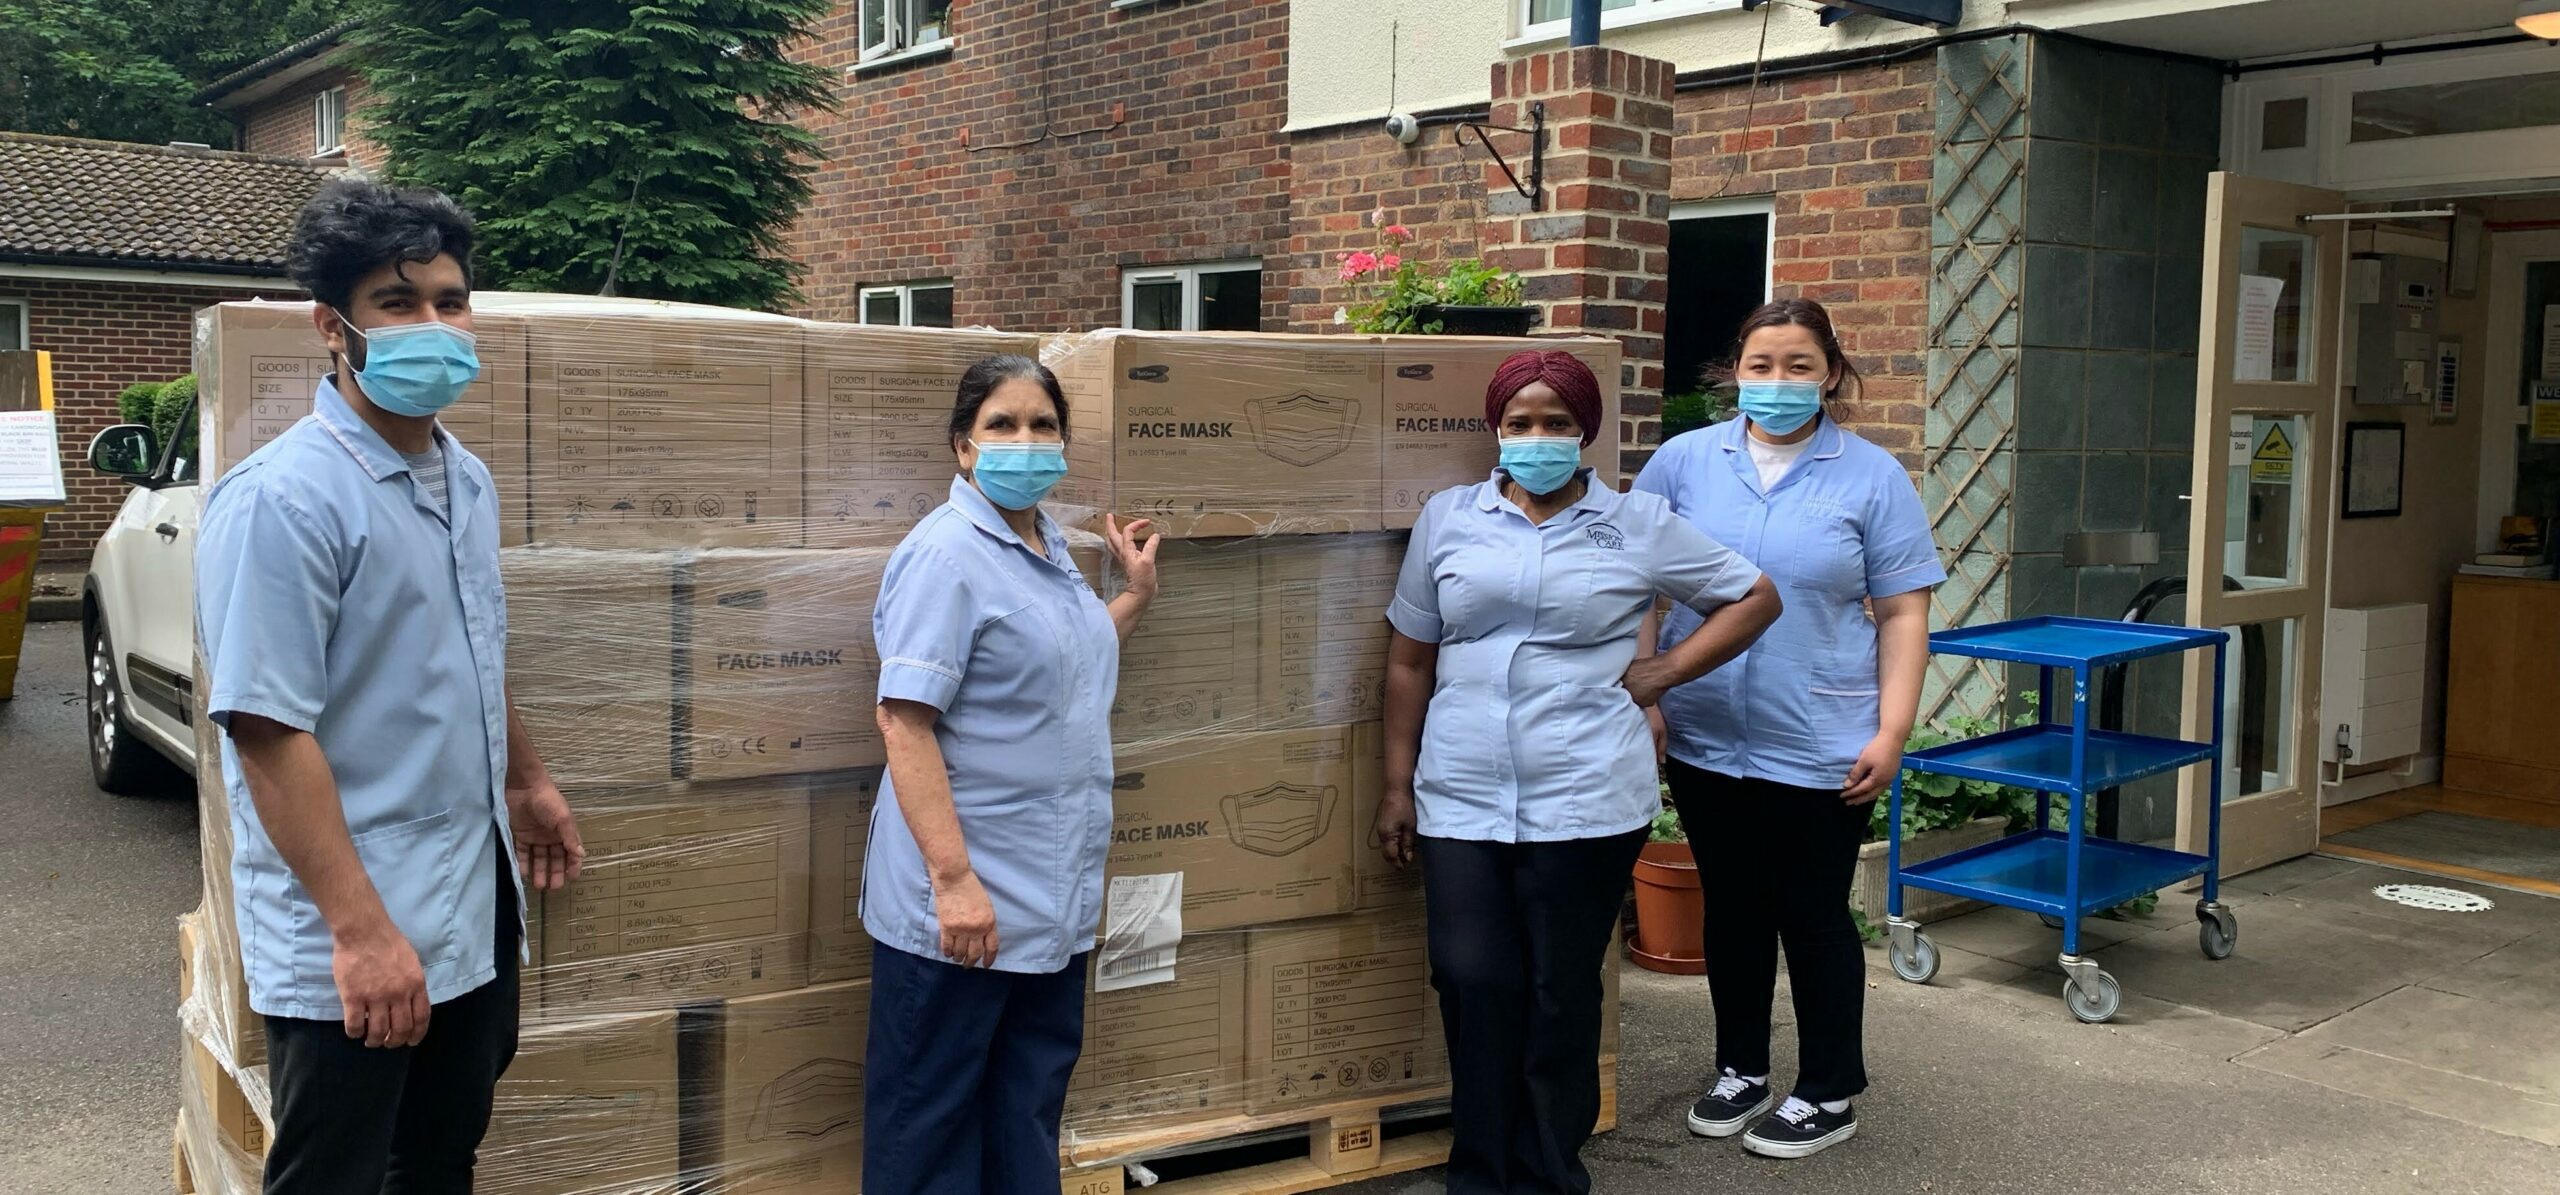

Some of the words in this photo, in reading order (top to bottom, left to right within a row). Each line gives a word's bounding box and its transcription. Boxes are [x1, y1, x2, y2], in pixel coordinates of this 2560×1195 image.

[257, 362, 300, 373] GOODS
[564, 368, 601, 377] GOODS
[667, 371, 694, 379] FACE
[695, 371, 721, 380] MASK
[834, 376, 866, 385] GOODS
[879, 378, 922, 387] SURGICAL
[924, 379, 946, 387] FACE
[258, 383, 282, 393] SIZE
[564, 387, 586, 395] SIZE
[834, 395, 854, 403] SIZE
[277, 405, 290, 414] TY
[581, 407, 593, 416] TY
[1128, 406, 1176, 416] SURGICAL
[1395, 403, 1439, 412] SURGICAL
[902, 414, 919, 422] PCS
[1396, 418, 1438, 432] FACE
[1442, 418, 1487, 432] MASK
[1128, 423, 1176, 438] FACE
[1180, 423, 1233, 438] MASK
[2235, 442, 2246, 450] Door
[566, 465, 587, 474] LOT
[717, 653, 776, 670] FACE
[780, 649, 843, 668] MASK
[1285, 663, 1300, 671] LOT
[1156, 821, 1209, 841] MASK
[586, 847, 613, 856] OODS
[592, 885, 604, 893] TY
[627, 881, 651, 890] 2000
[652, 879, 672, 888] PCS
[627, 900, 645, 909] 7kg
[576, 943, 598, 952] LOT
[1278, 967, 1304, 977] GOODS
[1314, 962, 1348, 973] SURGICAL
[1350, 959, 1368, 969] FACE
[1369, 957, 1390, 967] MASK
[1277, 984, 1292, 993] SIZE
[1289, 1000, 1297, 1008] TY
[1314, 995, 1332, 1005] 2000
[1333, 994, 1346, 1002] PCS
[1314, 1011, 1327, 1020] 7kg
[1101, 1022, 1119, 1032] 2000
[1120, 1020, 1135, 1029] PCS
[1277, 1048, 1293, 1056] LOT
[1080, 1181, 1111, 1195] ATG
